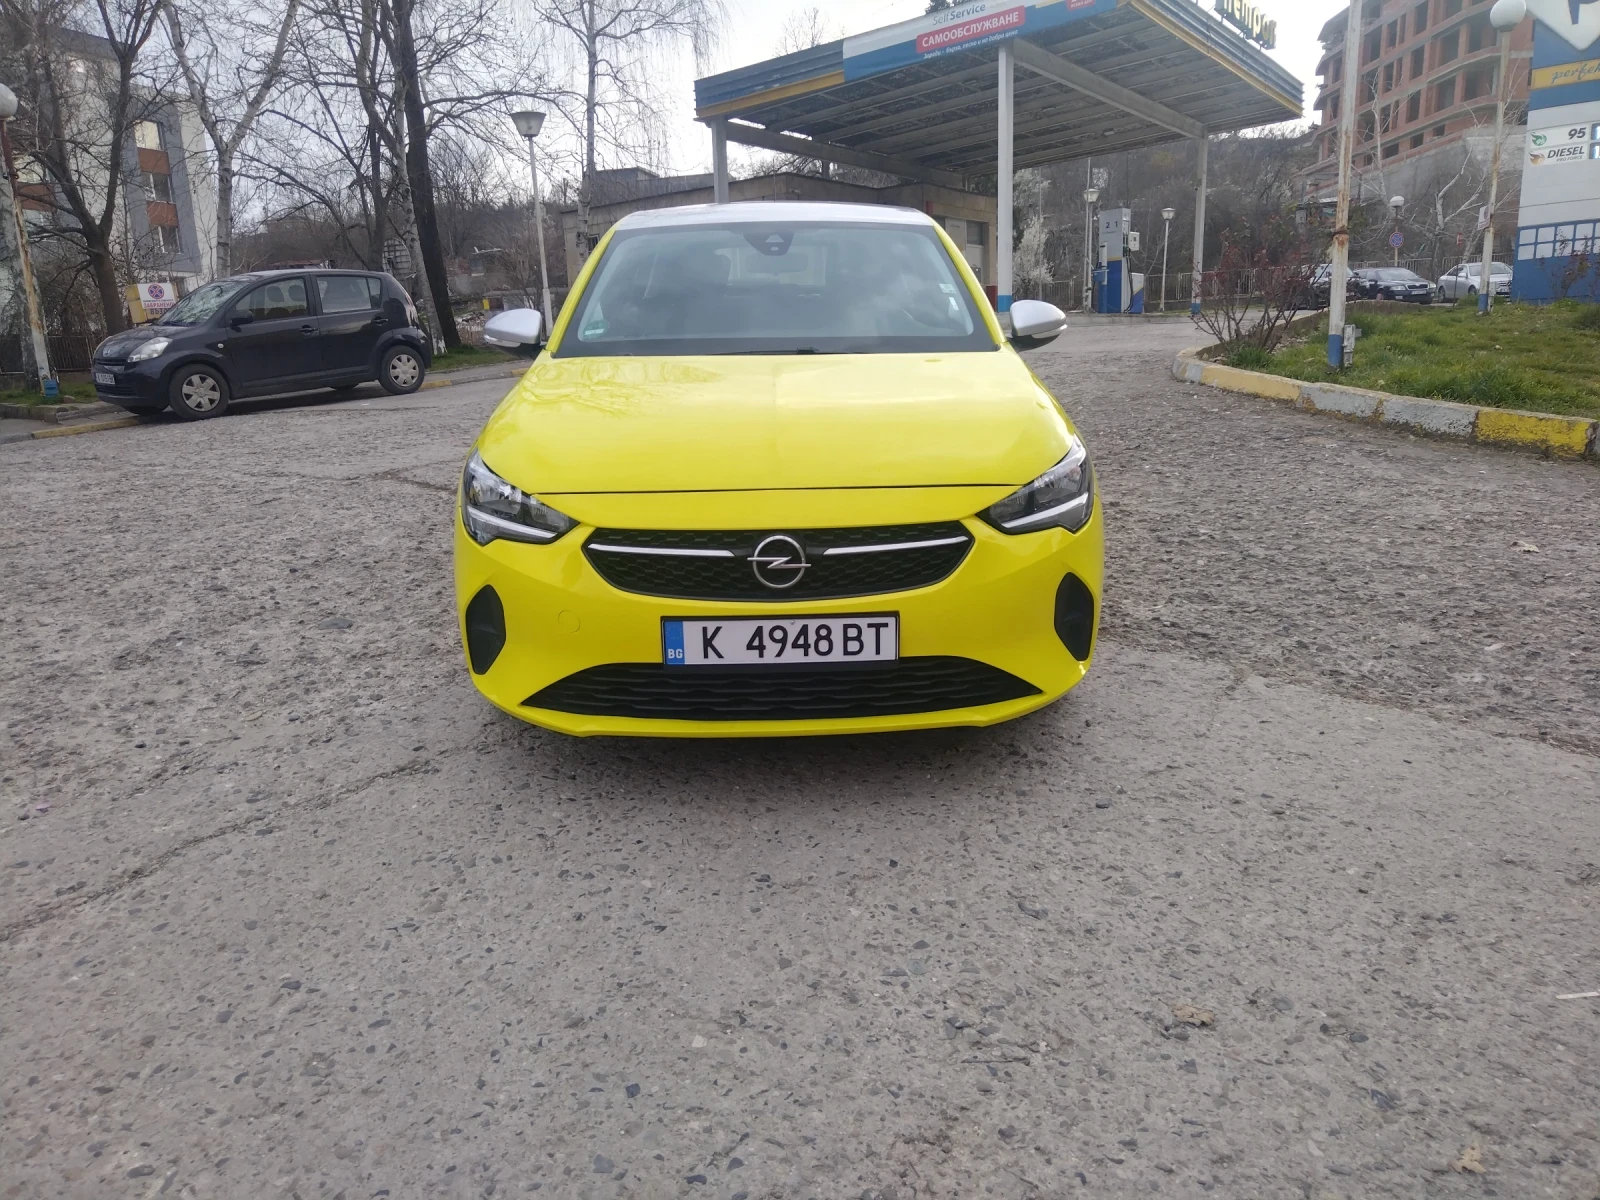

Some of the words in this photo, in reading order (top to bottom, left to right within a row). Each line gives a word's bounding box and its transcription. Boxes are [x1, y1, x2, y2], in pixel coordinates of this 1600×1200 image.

[932, 3, 986, 26] SelfService
[922, 11, 1019, 47] САМООБСЛУЖВАНЕ
[1568, 127, 1587, 140] 95
[1547, 145, 1585, 159] DIESEL
[1105, 221, 1111, 229] 2
[702, 626, 724, 659] K
[746, 624, 834, 659] 4948
[667, 648, 683, 659] BG
